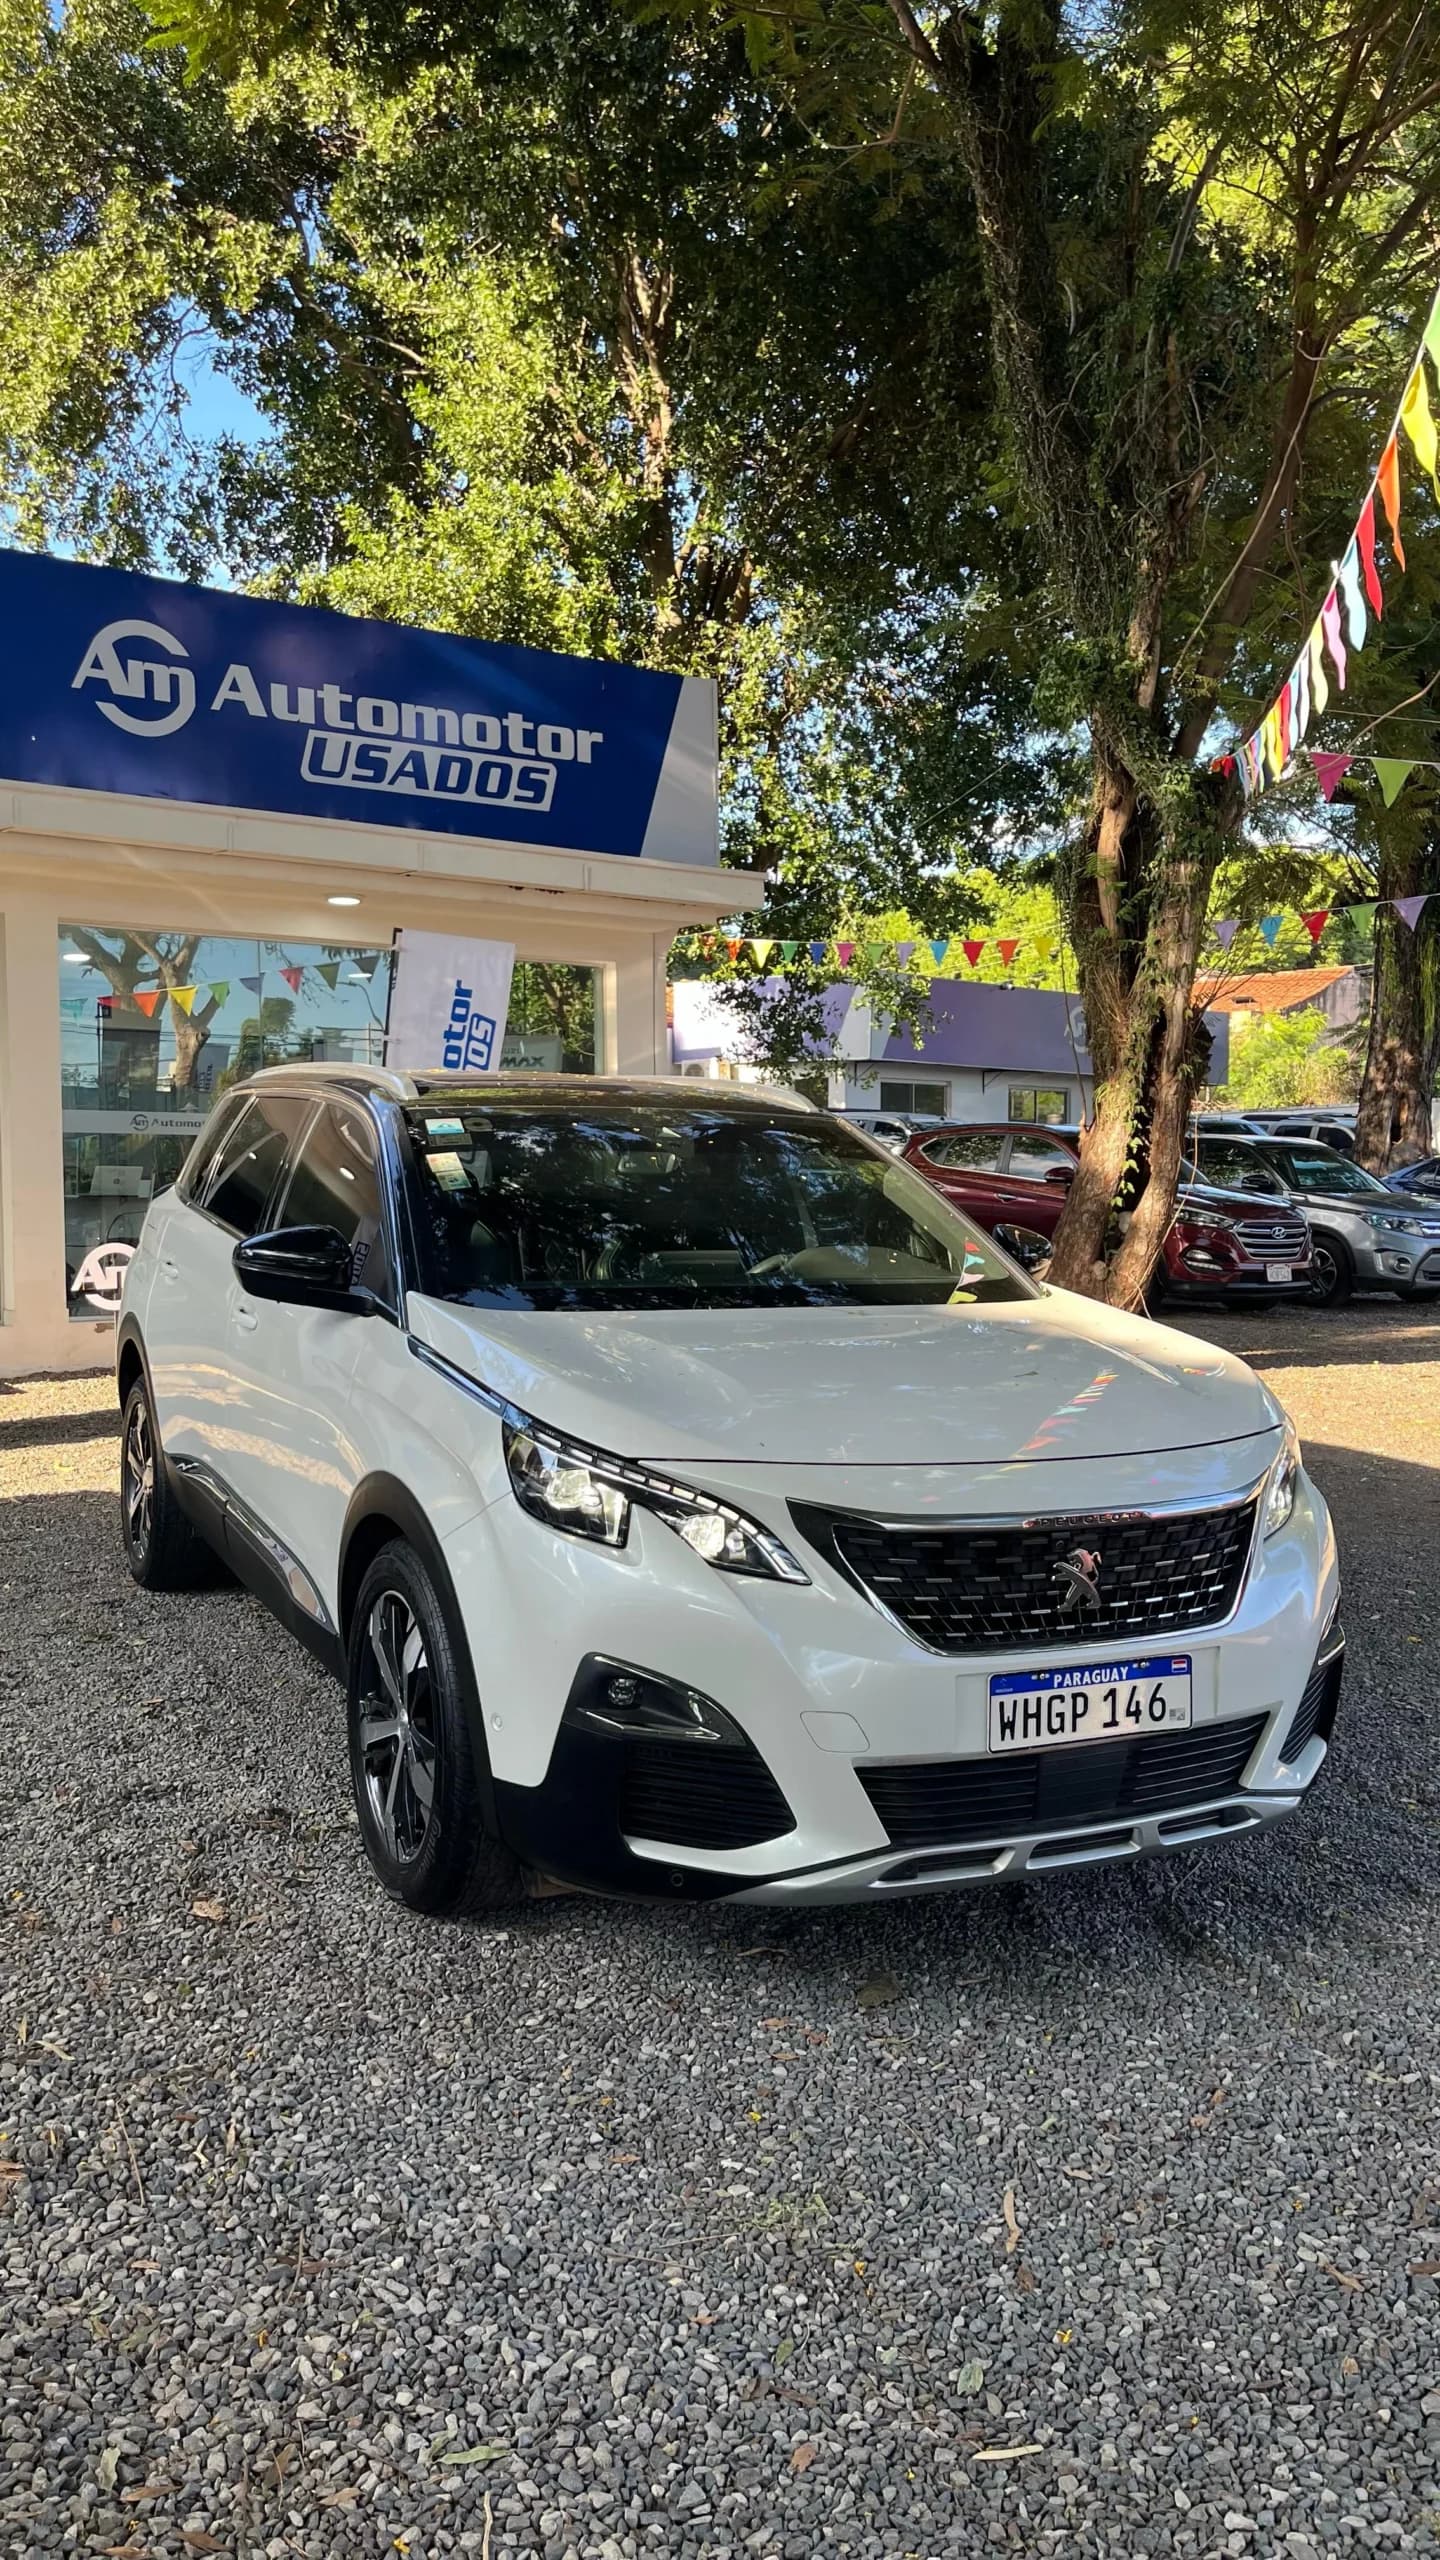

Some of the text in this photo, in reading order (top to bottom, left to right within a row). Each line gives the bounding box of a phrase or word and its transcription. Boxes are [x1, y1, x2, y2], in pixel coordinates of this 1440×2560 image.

[210, 663, 603, 763] Automotor
[308, 735, 551, 804] USADOS
[443, 979, 473, 1069] otor
[151, 1117, 205, 1128] Automo
[1040, 1511, 1136, 1528] PEUGEOT
[1053, 1666, 1129, 1688] PARAGUAY
[999, 1682, 1167, 1741] WHGP 146
